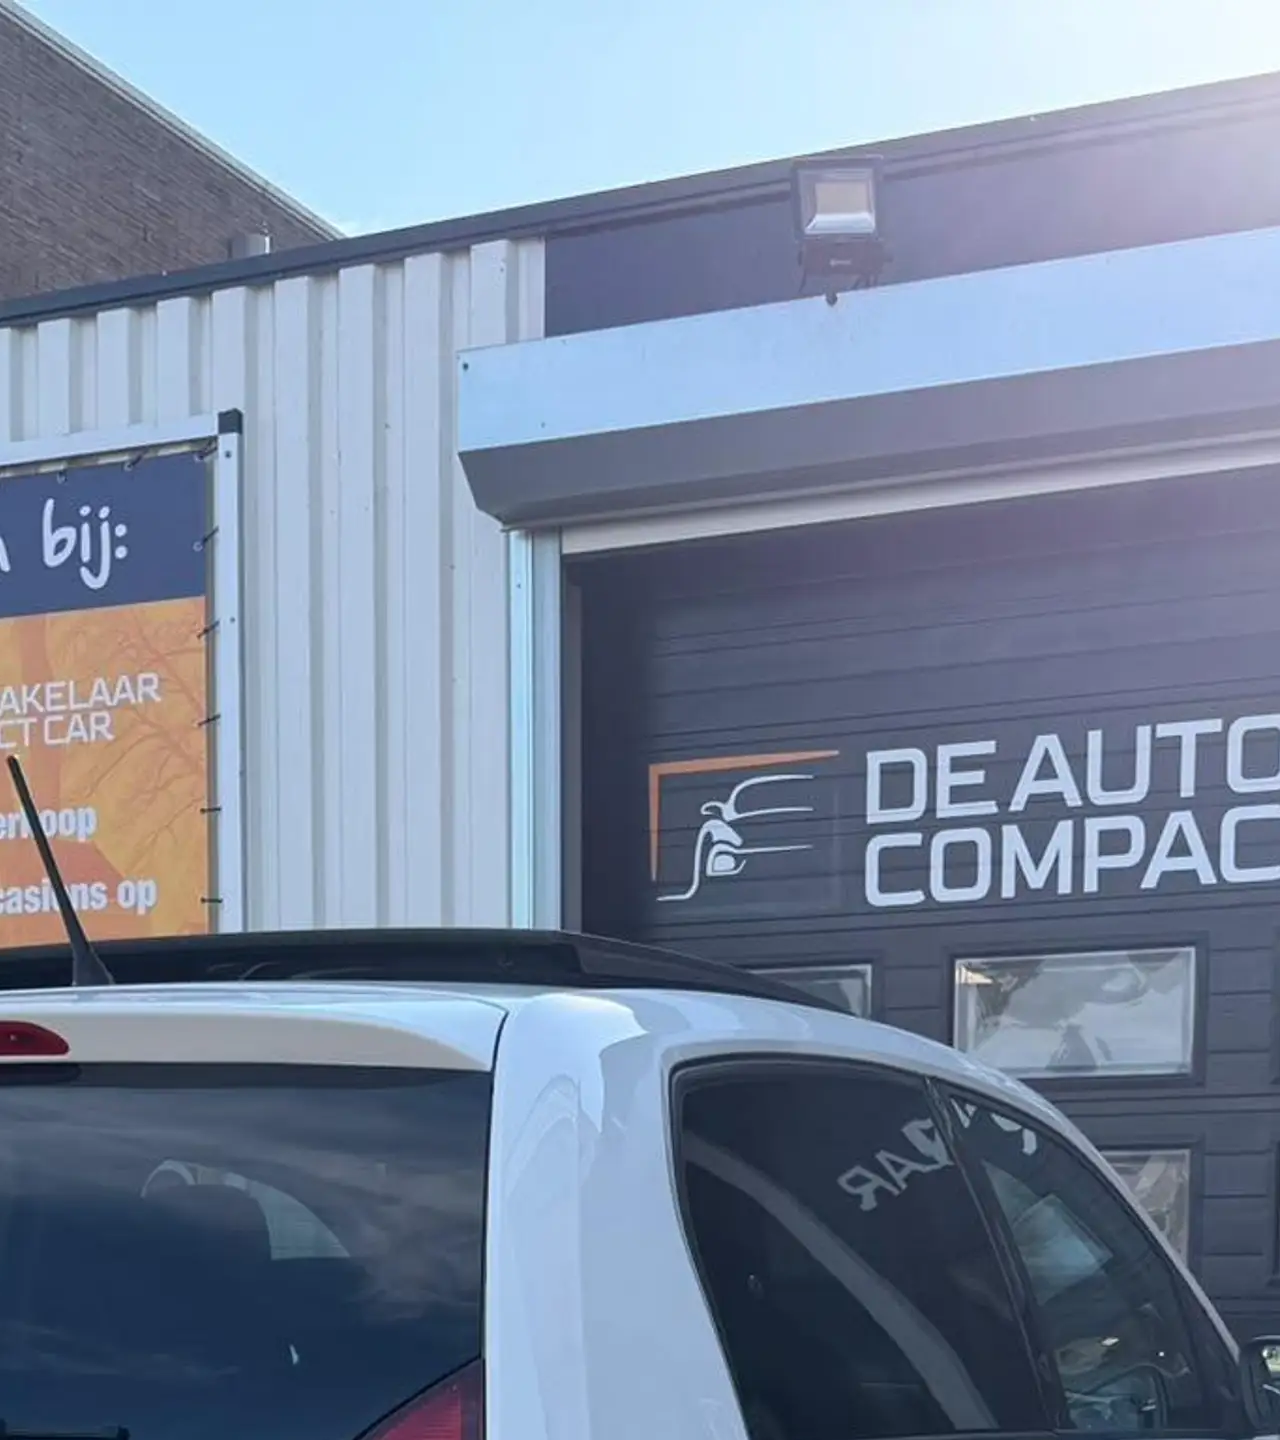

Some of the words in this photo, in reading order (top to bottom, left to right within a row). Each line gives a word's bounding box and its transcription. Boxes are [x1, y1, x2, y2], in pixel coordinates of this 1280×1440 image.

[42, 498, 128, 590] bij:
[44, 710, 115, 746] CAR
[866, 740, 998, 824] DE
[117, 879, 158, 915] op
